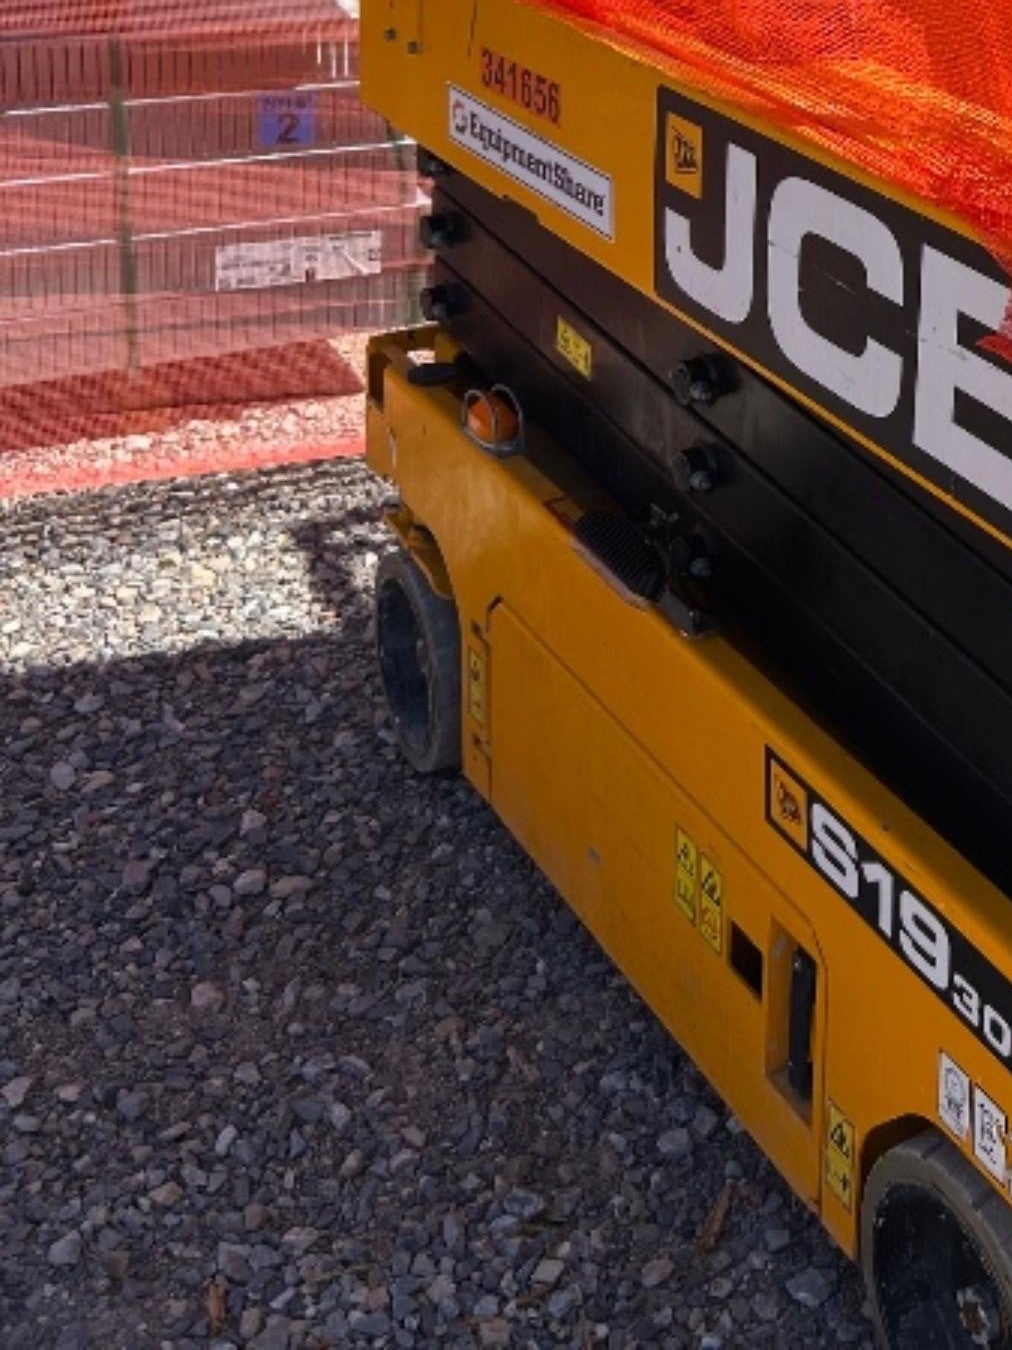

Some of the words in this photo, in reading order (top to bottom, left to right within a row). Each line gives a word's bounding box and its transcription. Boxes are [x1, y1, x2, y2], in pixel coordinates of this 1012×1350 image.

[481, 47, 560, 125] 341656
[275, 113, 302, 145] 2
[469, 109, 606, 218] EquipmentShare
